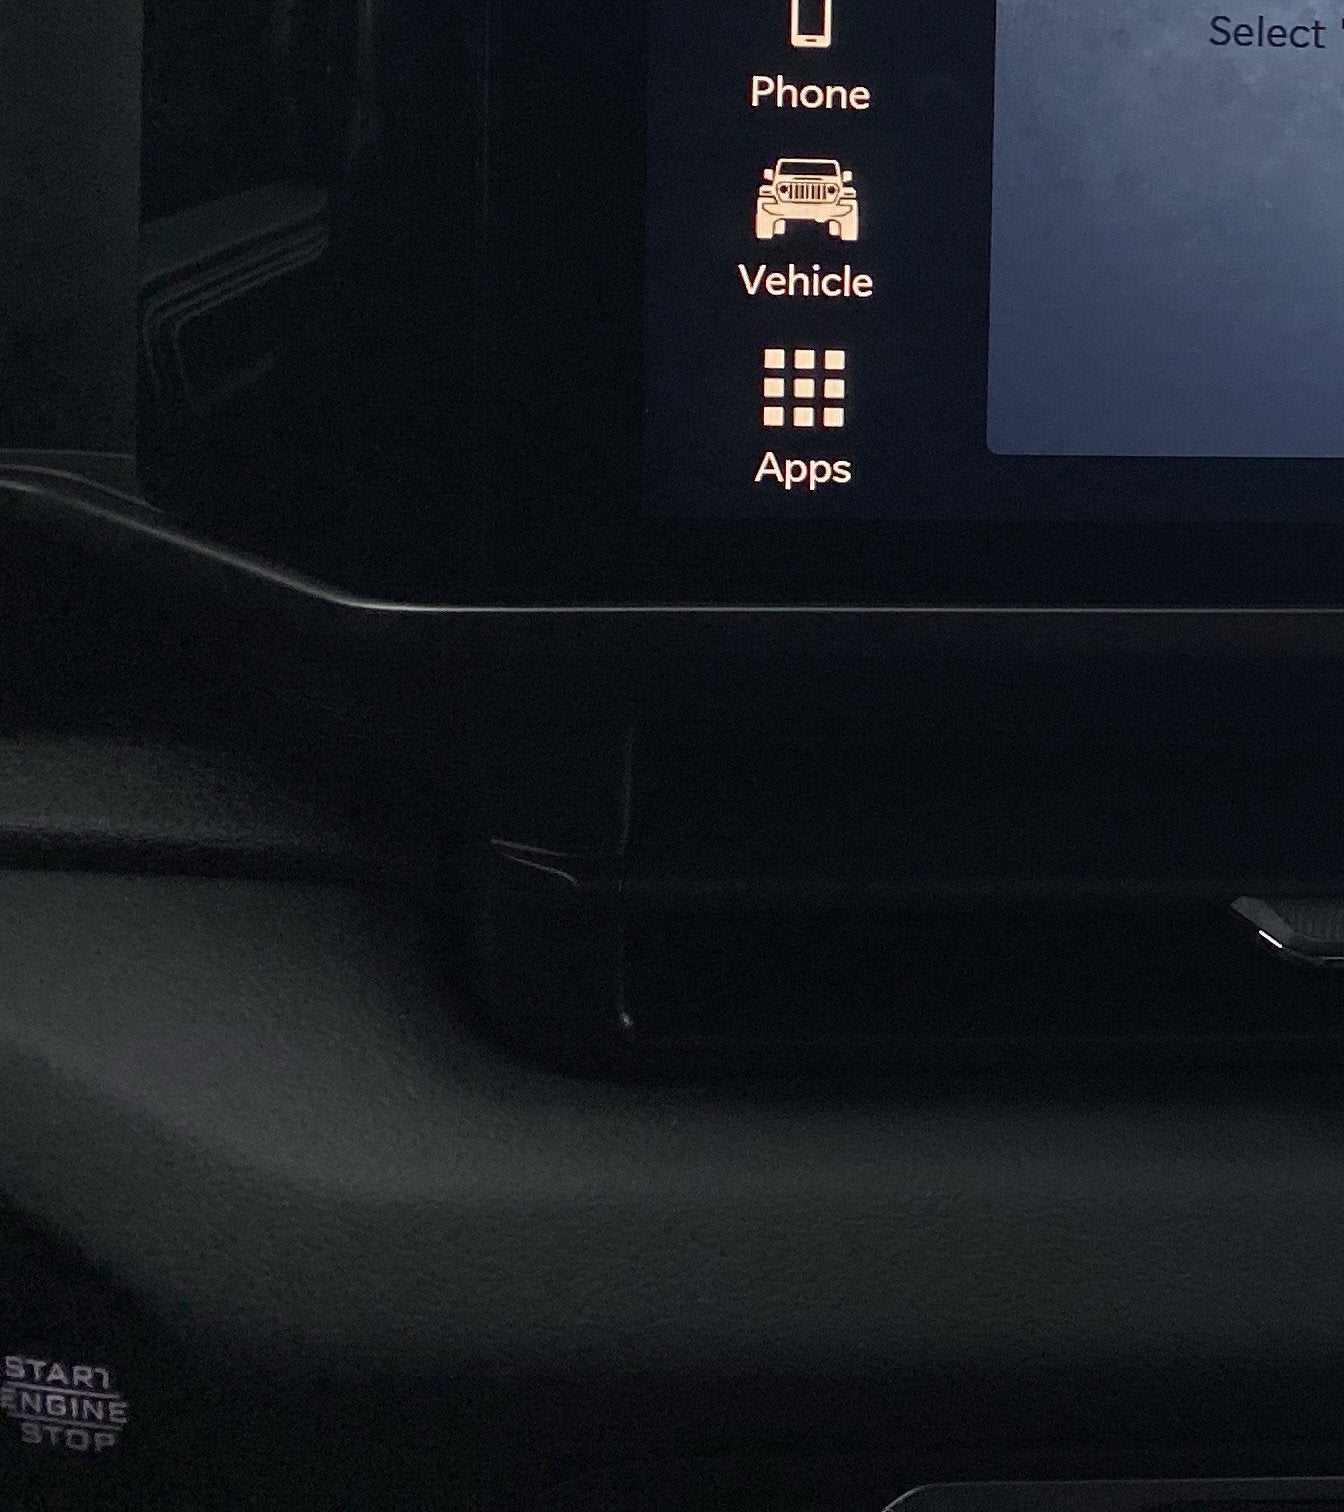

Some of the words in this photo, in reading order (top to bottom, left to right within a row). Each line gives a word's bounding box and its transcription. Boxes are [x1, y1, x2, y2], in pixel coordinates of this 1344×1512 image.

[1208, 14, 1327, 51] Select
[751, 74, 871, 110] Phone
[738, 262, 874, 298] Vehicle
[754, 452, 852, 491] Apps
[4, 1354, 111, 1390] START
[0, 1387, 129, 1424] ENGINE
[21, 1421, 117, 1453] STOP
